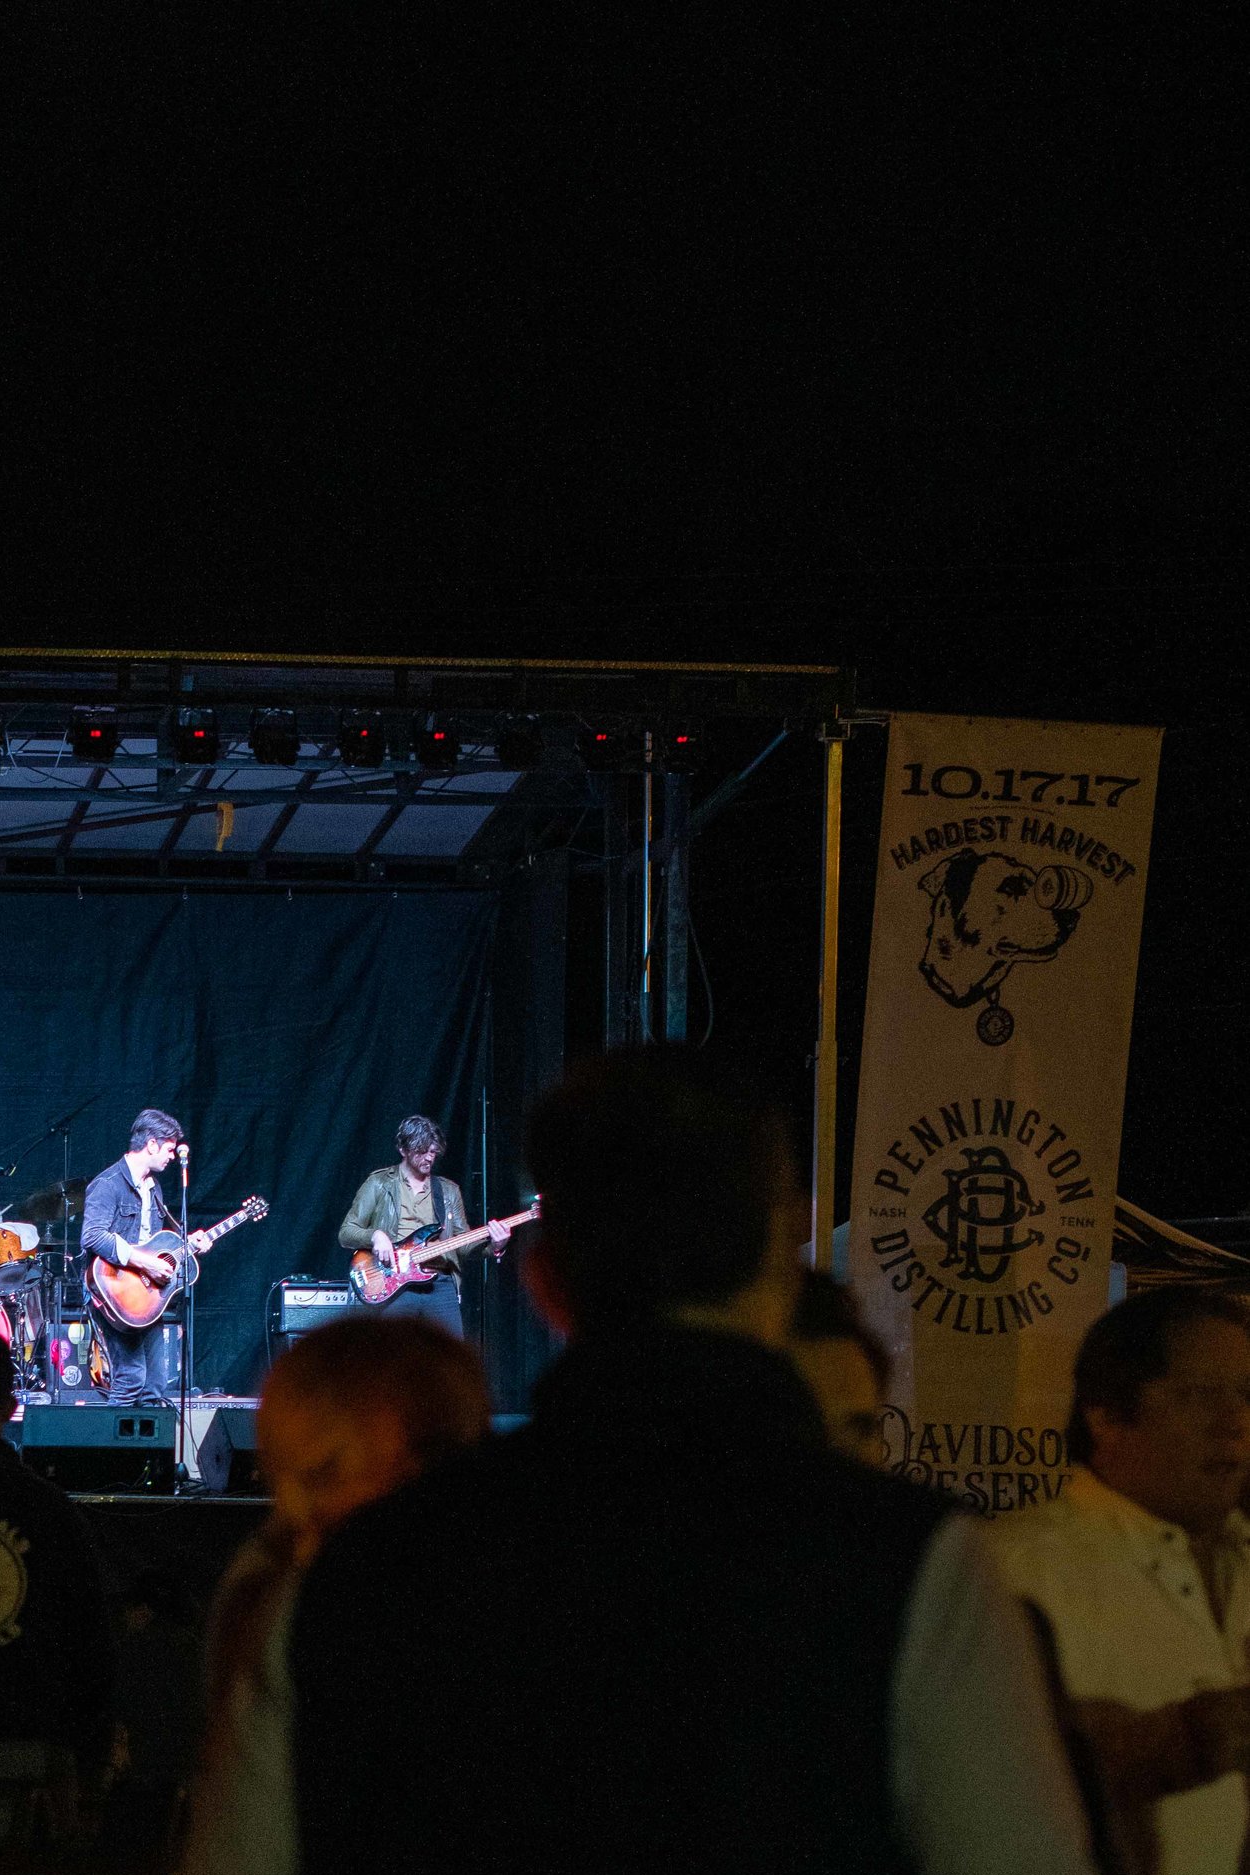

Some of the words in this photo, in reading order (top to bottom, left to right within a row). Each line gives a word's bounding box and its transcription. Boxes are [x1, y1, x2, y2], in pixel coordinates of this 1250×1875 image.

[901, 763, 1140, 808] 10.17.17
[890, 816, 1013, 870] HARDEST
[1021, 816, 1136, 885] HARVEST
[874, 1098, 1094, 1204] PENNINGTON
[868, 1207, 907, 1218] NASH
[1060, 1216, 1095, 1228] TENN
[870, 1228, 1055, 1335] DISTILLING
[880, 1403, 1072, 1473] DAVIDSO
